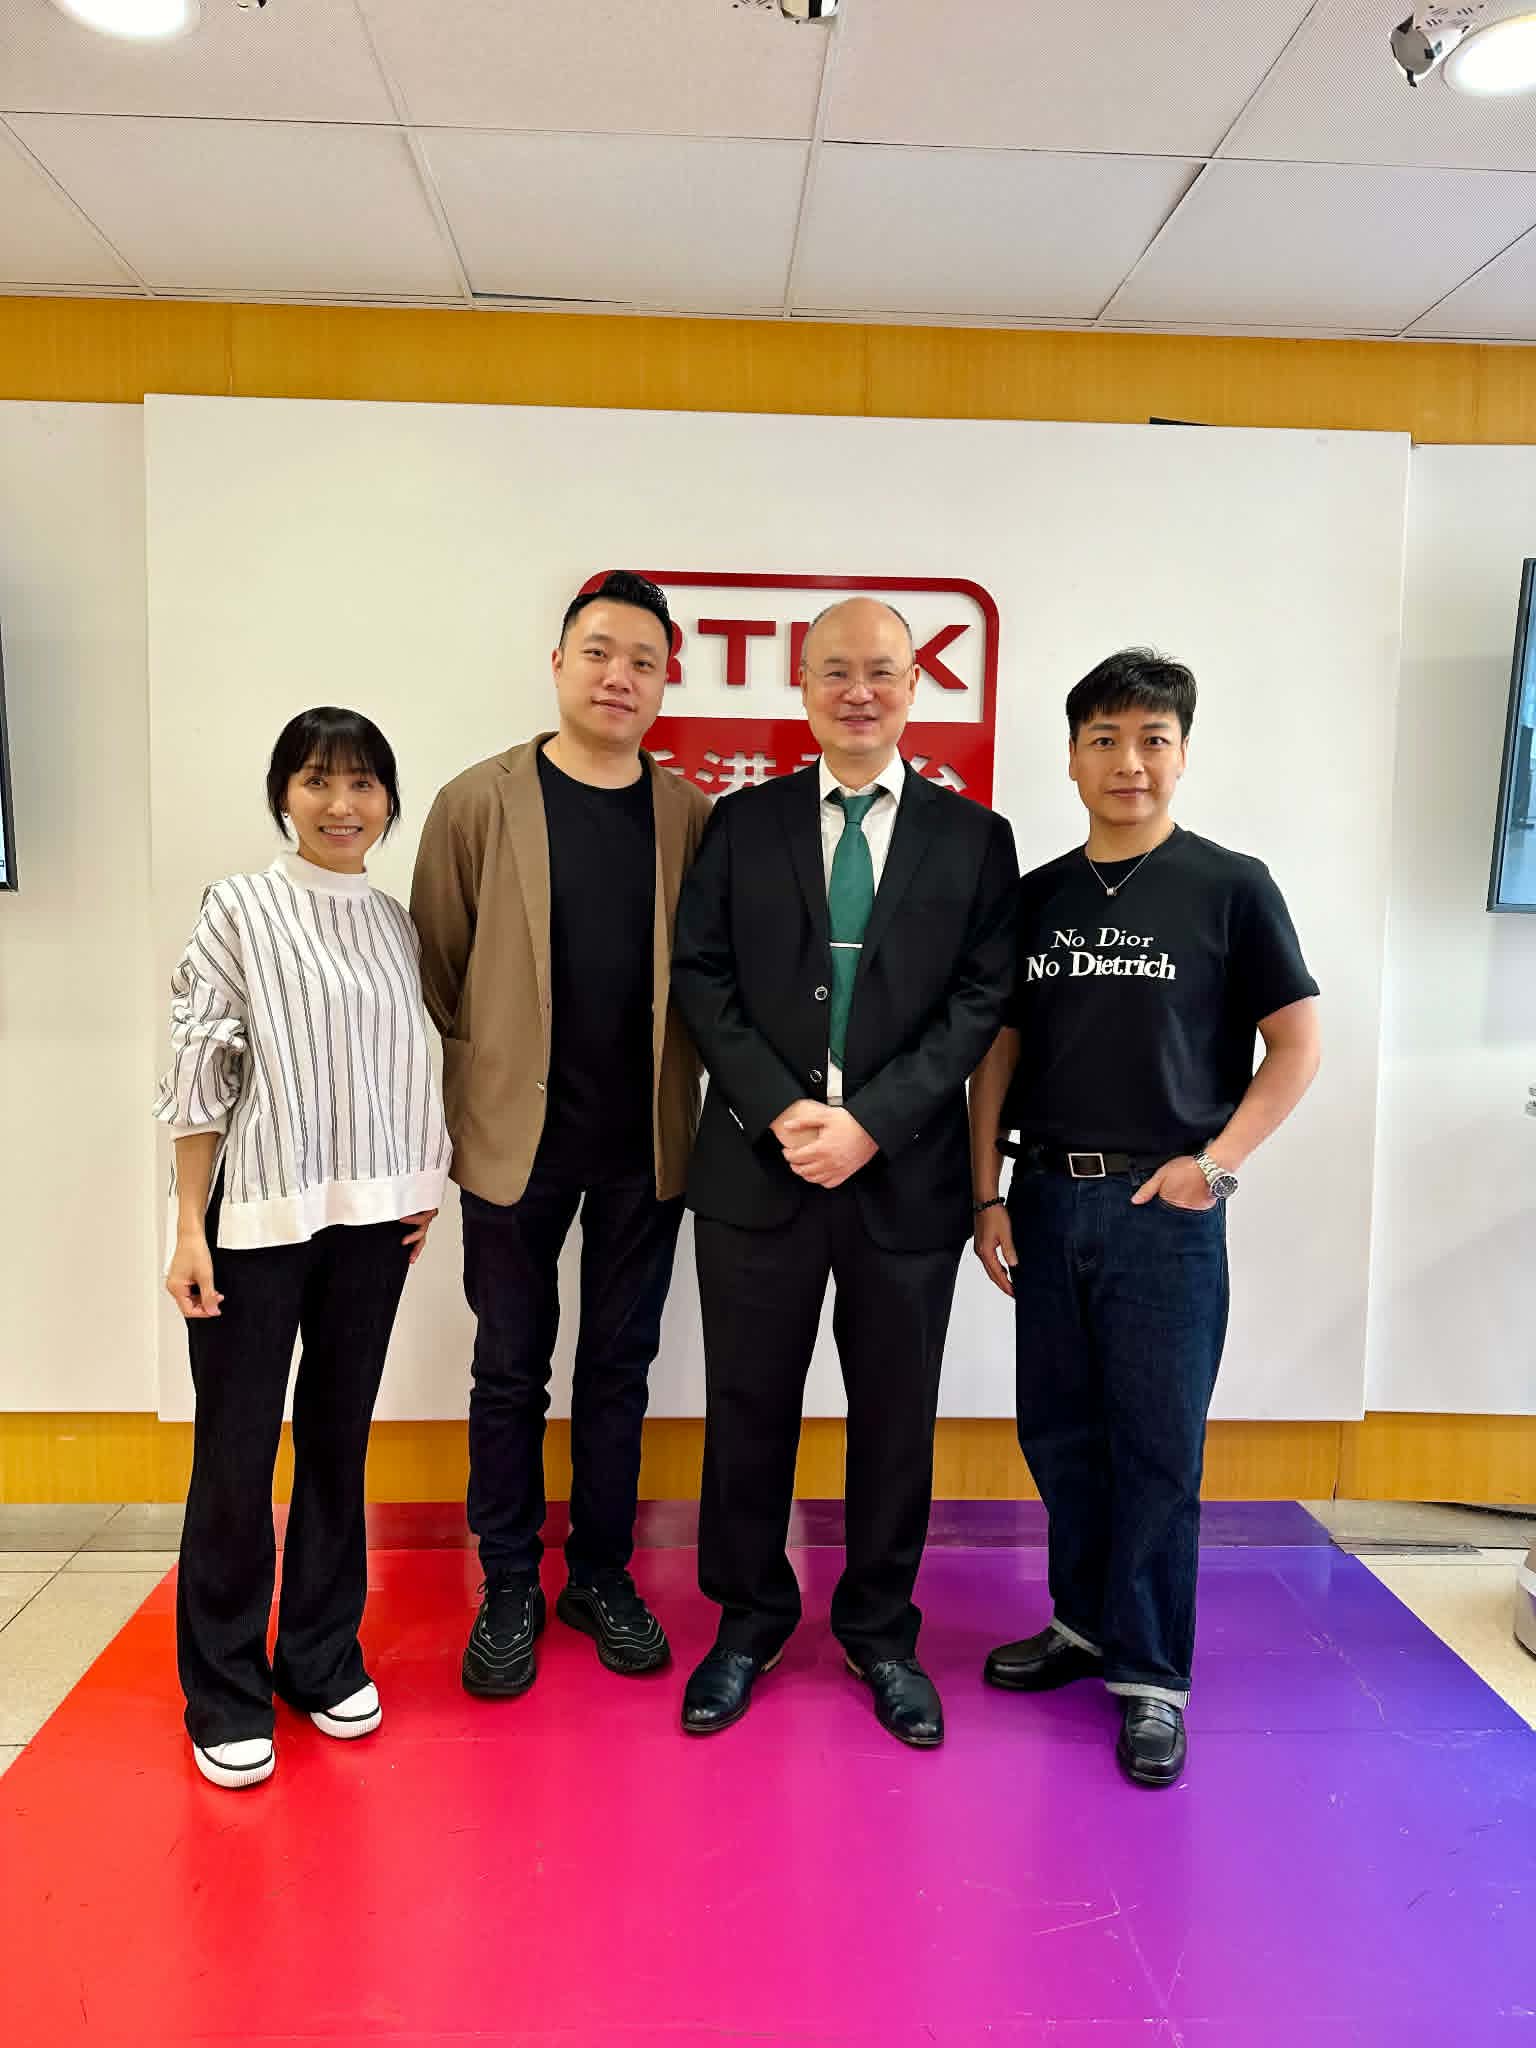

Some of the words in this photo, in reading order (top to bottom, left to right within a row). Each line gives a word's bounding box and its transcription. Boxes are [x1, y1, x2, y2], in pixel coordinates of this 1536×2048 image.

[666, 619, 971, 690] TK
[1050, 928, 1086, 949] No
[1096, 927, 1154, 948] Dior
[1025, 953, 1061, 982] No
[1069, 950, 1177, 980] Dietrich
